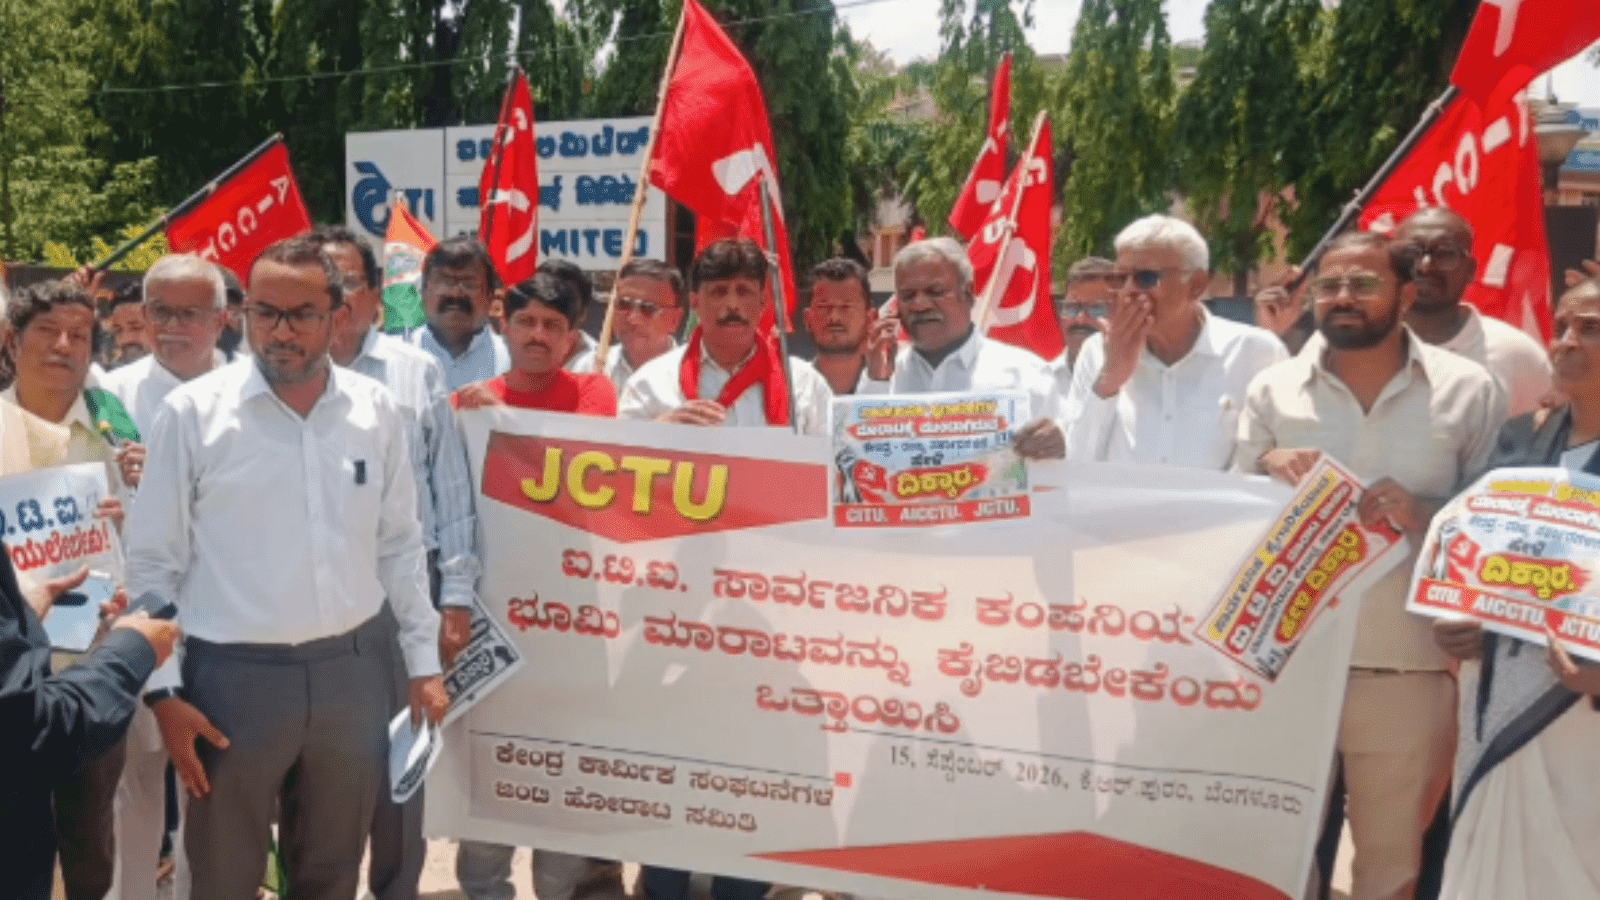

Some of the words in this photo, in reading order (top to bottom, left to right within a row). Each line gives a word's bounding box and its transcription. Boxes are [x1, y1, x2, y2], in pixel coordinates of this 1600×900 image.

[541, 228, 649, 257] MITED
[521, 447, 729, 522] JCTU
[0, 496, 84, 536] .ಟಿ.ಐ.
[561, 549, 688, 592] ಐ.ಟಿ.ಐ.
[713, 567, 948, 622] ಸಾರ್ವಜನಿಕ
[507, 591, 623, 639] ಭೂಮಿ
[643, 611, 911, 687] ಮಾರಾಟವನ್ನು
[937, 641, 1264, 712] ಕೈಬಿಡಬೇಕೆಂದು
[756, 684, 961, 735] ಒತ್ತಾಯಿಸಿ
[495, 742, 565, 776] ಕೇಂದ್ರ
[578, 754, 676, 785] ಕಾರ್ಮಿಕ
[689, 769, 835, 807] ಸಂಘಟನೆಗಳ
[891, 745, 917, 768] 15,
[495, 779, 550, 804] ಜಂಟಿ
[564, 786, 672, 821] ಹೋರಾಟ
[685, 804, 758, 833] ಸಮಿತಿ
